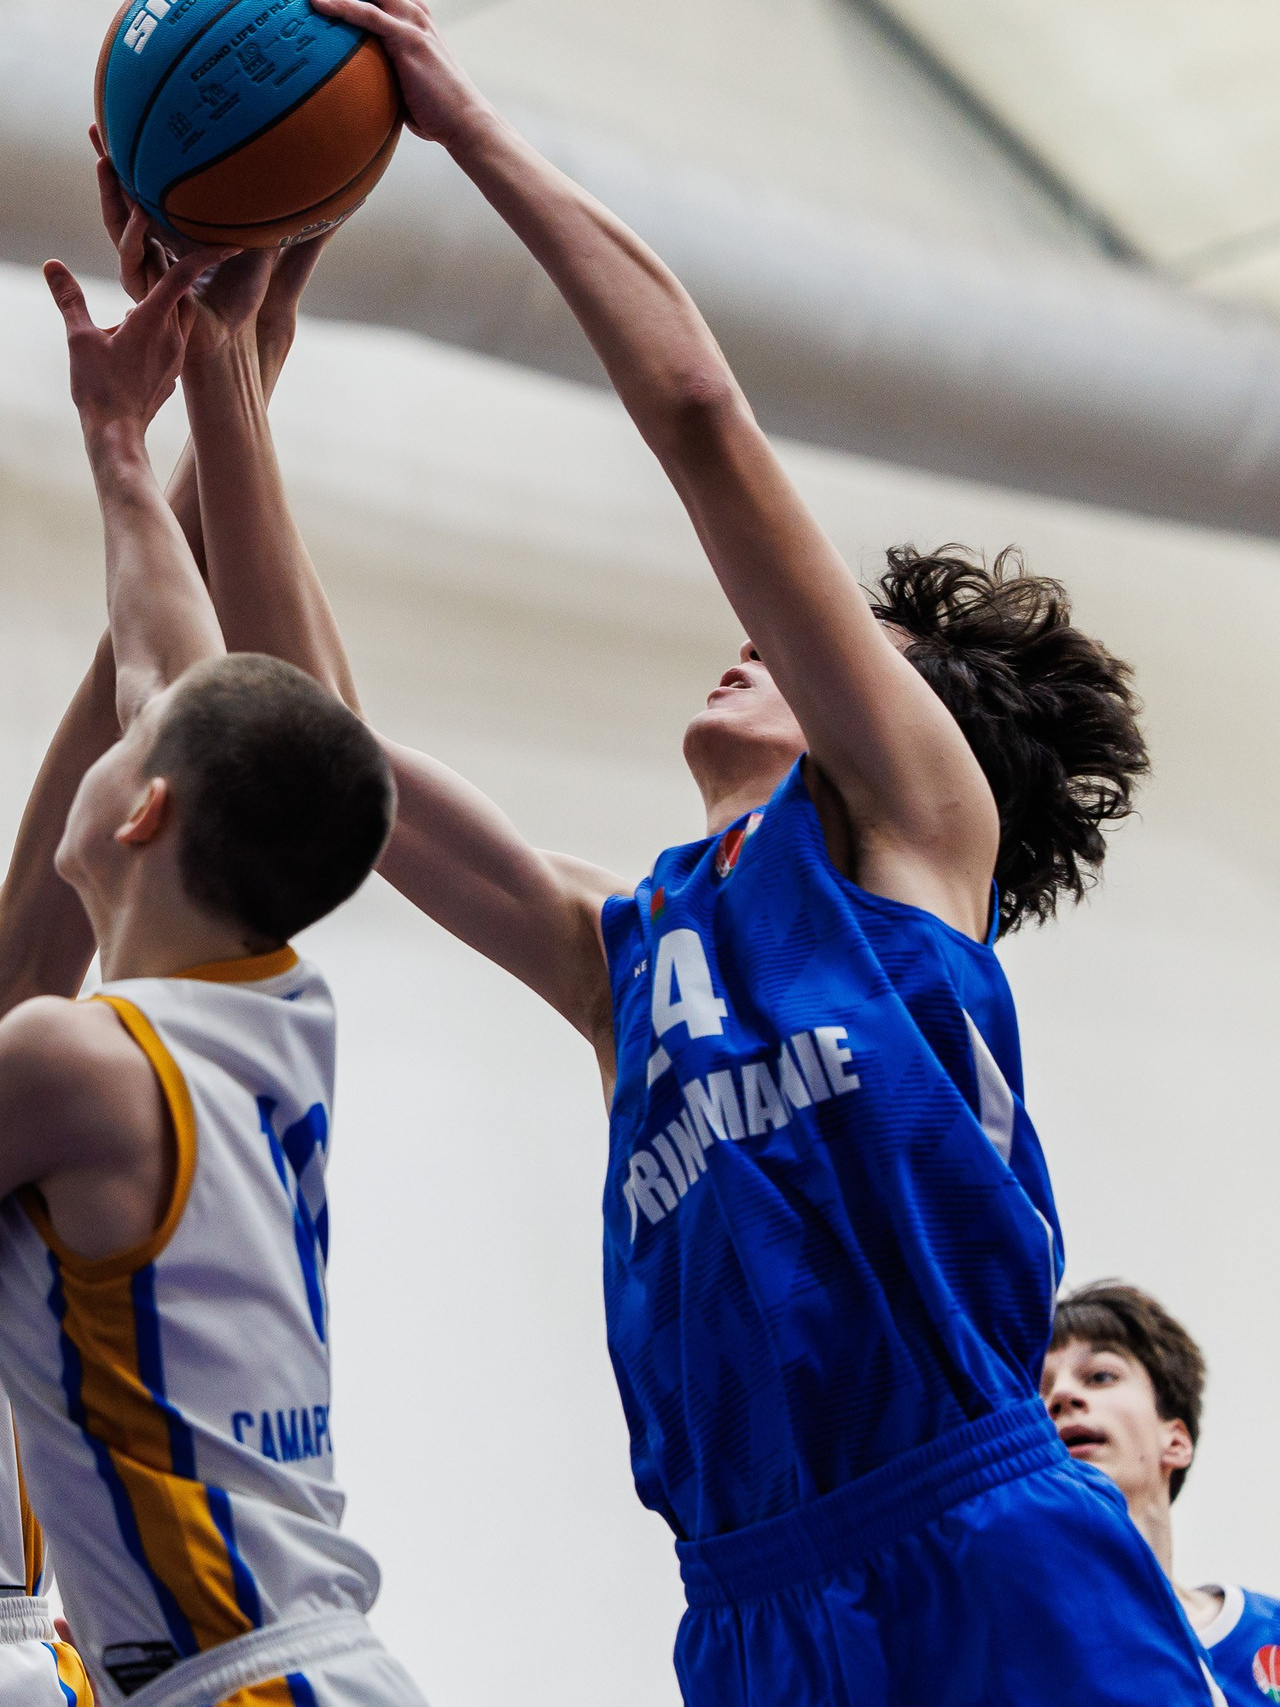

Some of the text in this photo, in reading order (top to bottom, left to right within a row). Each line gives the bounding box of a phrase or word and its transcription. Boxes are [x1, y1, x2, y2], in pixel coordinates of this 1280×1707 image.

[123, 0, 177, 54] SI
[230, 24, 257, 48] LIFE
[269, 0, 297, 16] PLA
[648, 929, 728, 1089] 4
[231, 1404, 332, 1462] САМАР
